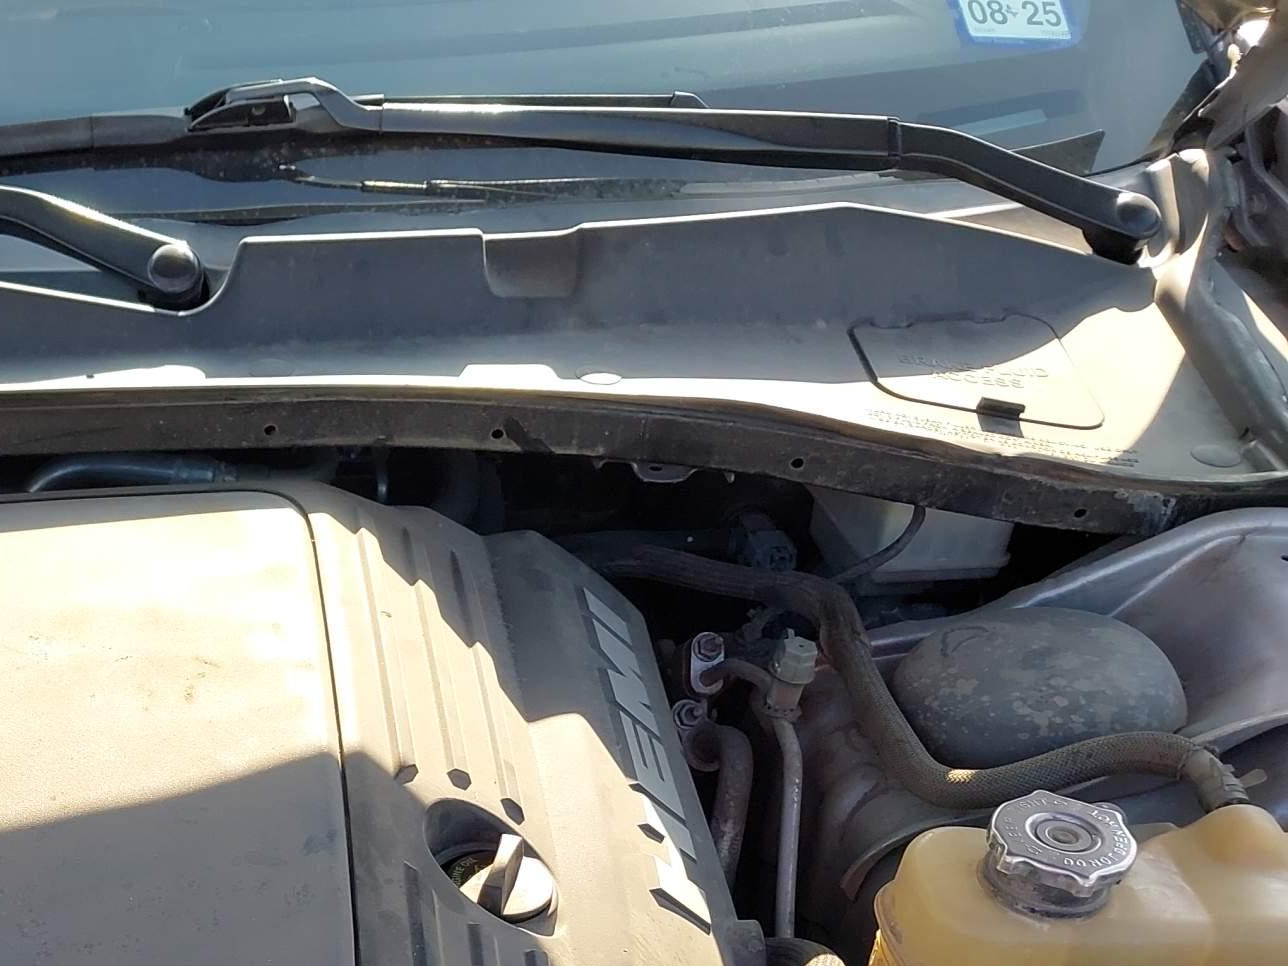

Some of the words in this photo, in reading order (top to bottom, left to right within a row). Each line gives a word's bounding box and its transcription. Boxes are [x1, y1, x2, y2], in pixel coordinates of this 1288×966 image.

[968, 0, 1008, 25] 08
[1021, 1, 1062, 27] 25
[584, 587, 711, 934] HEMI
